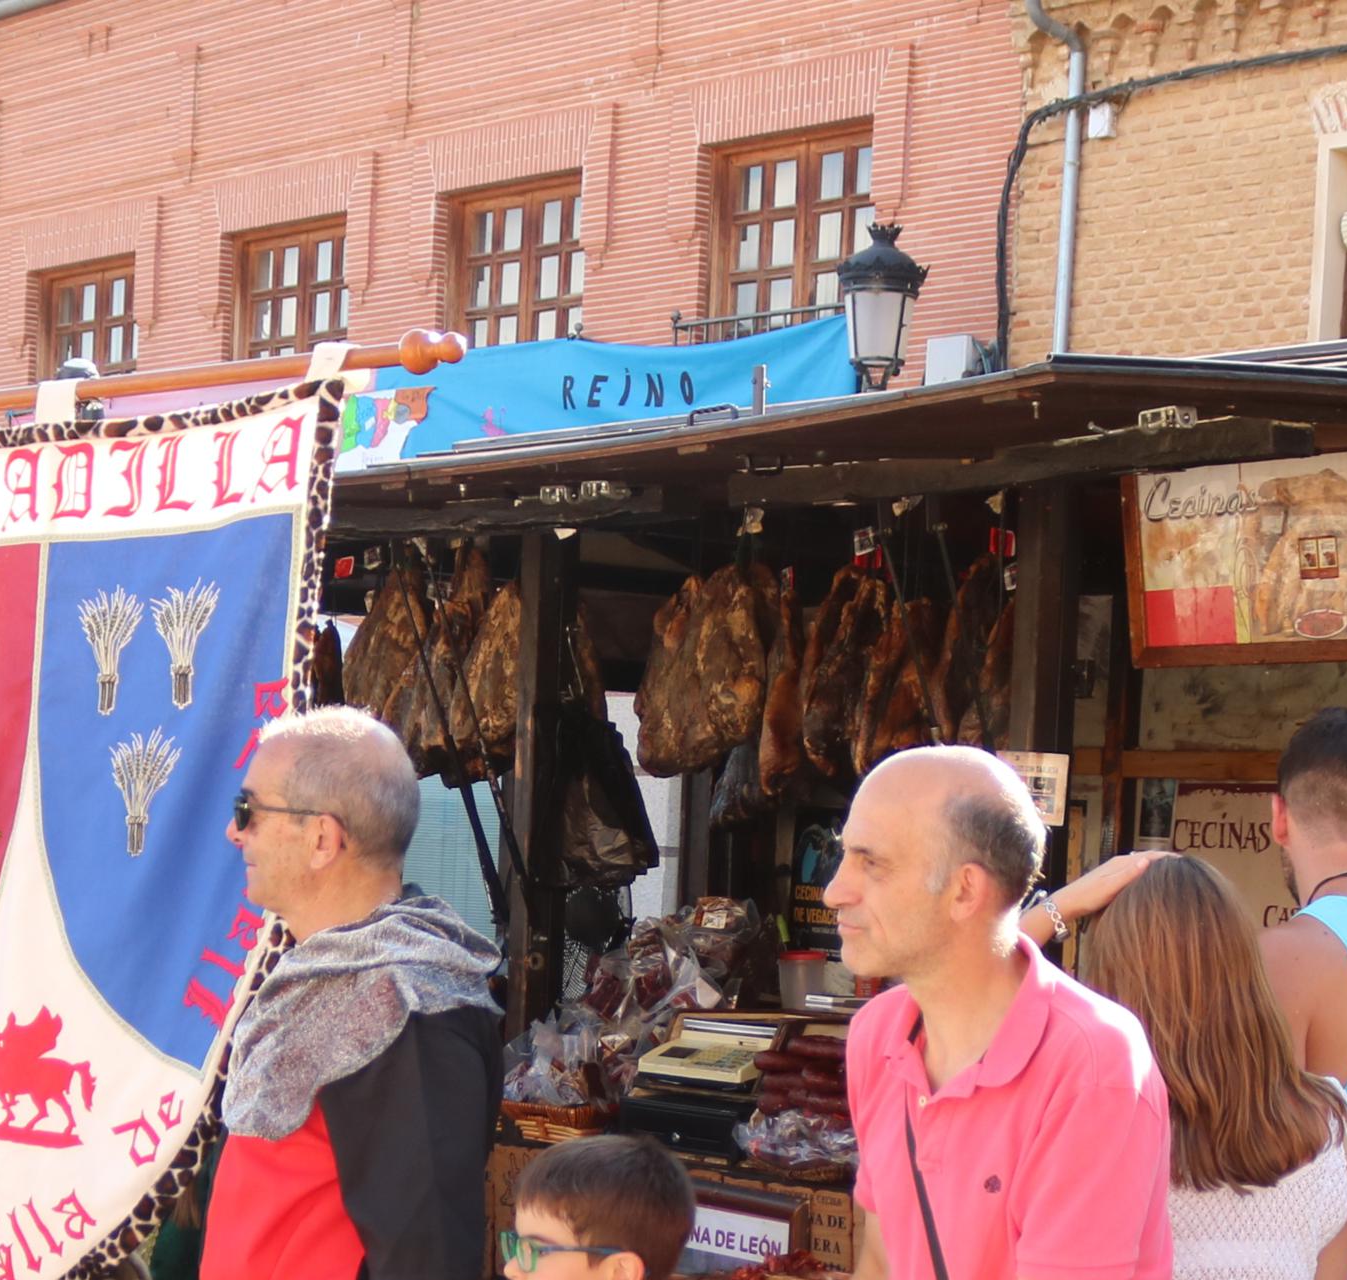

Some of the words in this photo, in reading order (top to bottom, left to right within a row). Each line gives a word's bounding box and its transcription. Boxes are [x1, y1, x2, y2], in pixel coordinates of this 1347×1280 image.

[1144, 475, 1259, 522] Cecinas
[111, 1090, 184, 1167] de
[828, 1215, 847, 1230] DE
[715, 1229, 735, 1250] DE
[739, 1233, 782, 1257] LEÓN
